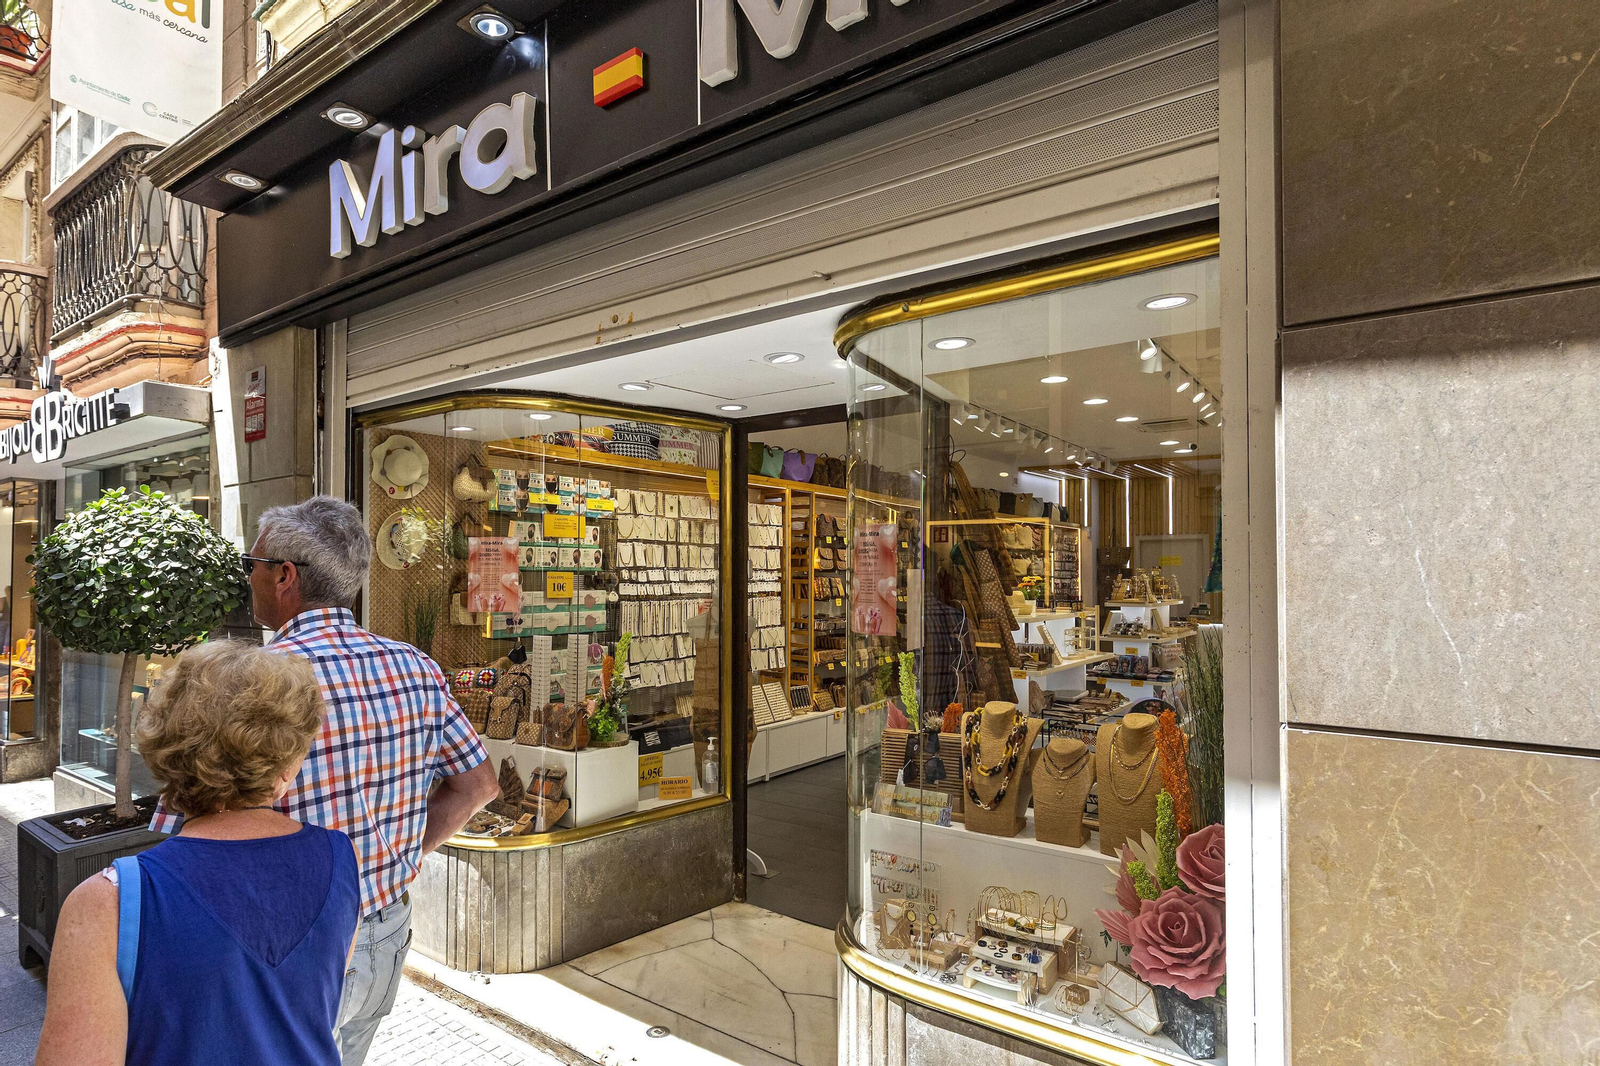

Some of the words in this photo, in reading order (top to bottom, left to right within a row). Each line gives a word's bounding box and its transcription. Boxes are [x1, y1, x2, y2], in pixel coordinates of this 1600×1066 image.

[163, 19, 208, 43] cercana
[329, 92, 538, 259] Mira
[612, 432, 652, 445] SUMMER
[552, 582, 567, 592] 10€
[640, 766, 663, 781] 4.95€
